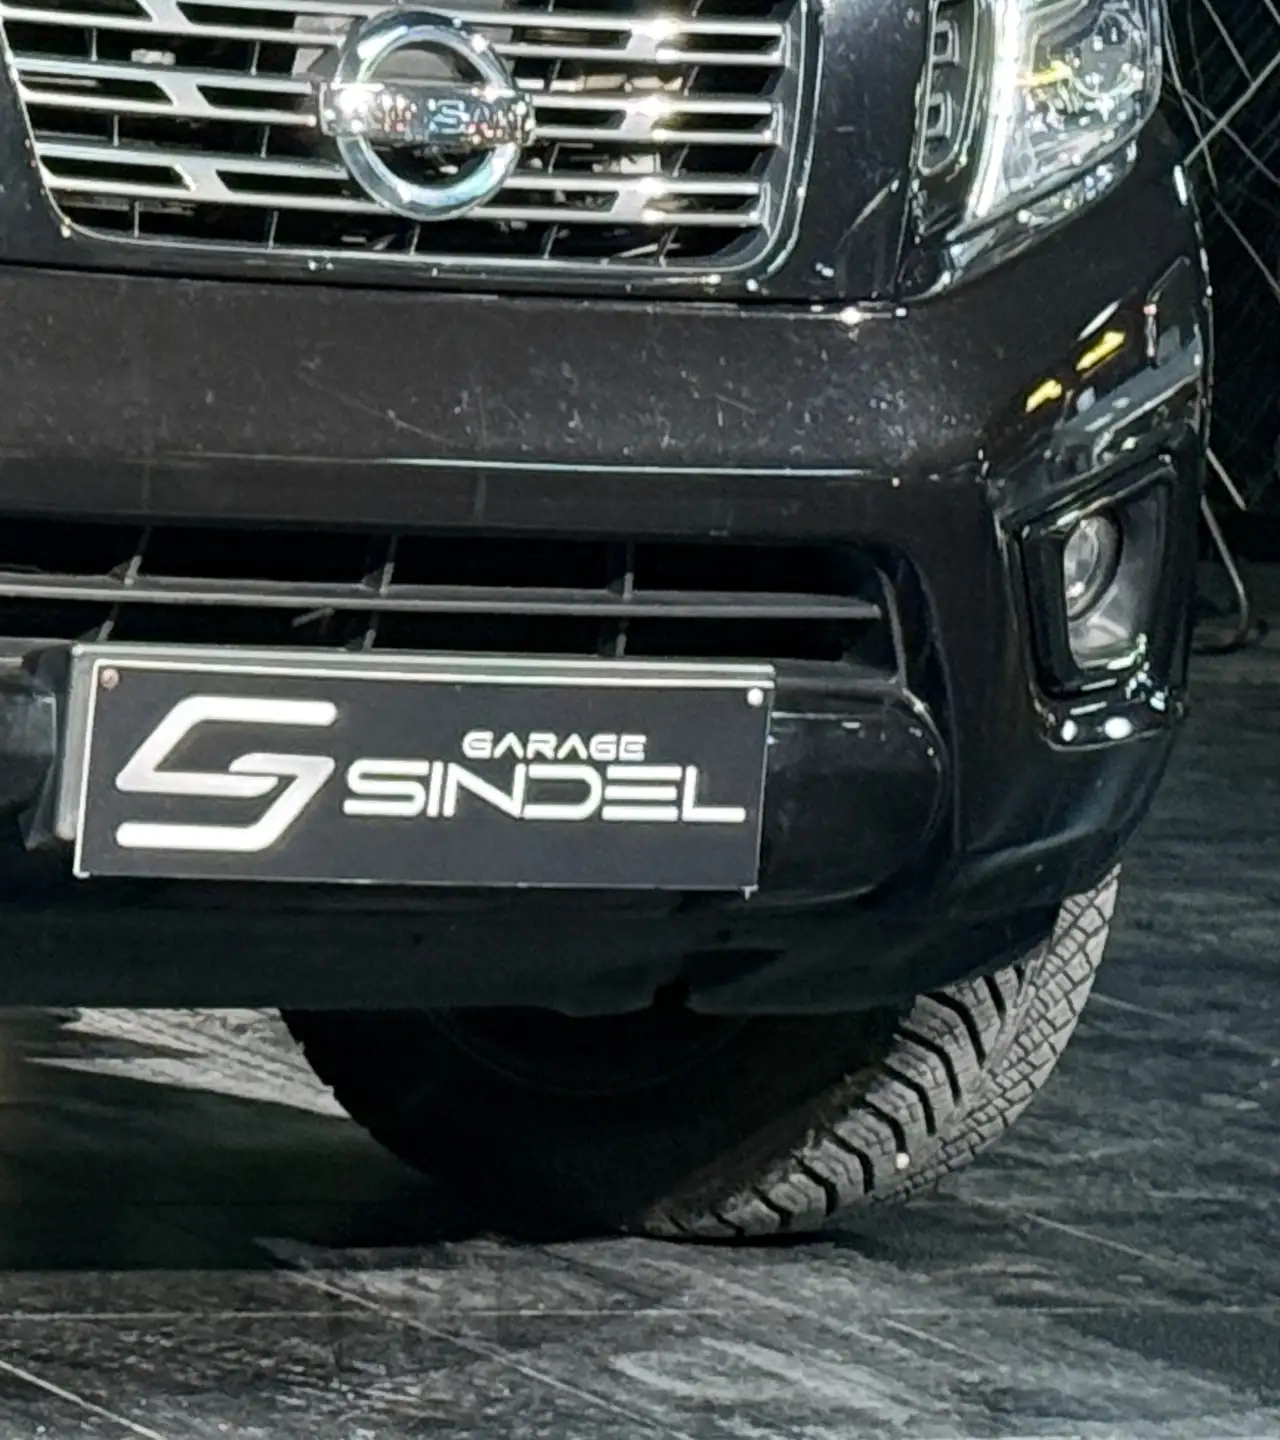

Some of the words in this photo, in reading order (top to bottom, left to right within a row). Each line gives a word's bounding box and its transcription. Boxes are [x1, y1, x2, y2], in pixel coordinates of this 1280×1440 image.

[358, 96, 524, 143] SAN
[462, 730, 648, 758] GARAGE
[344, 759, 747, 822] SINDEL
